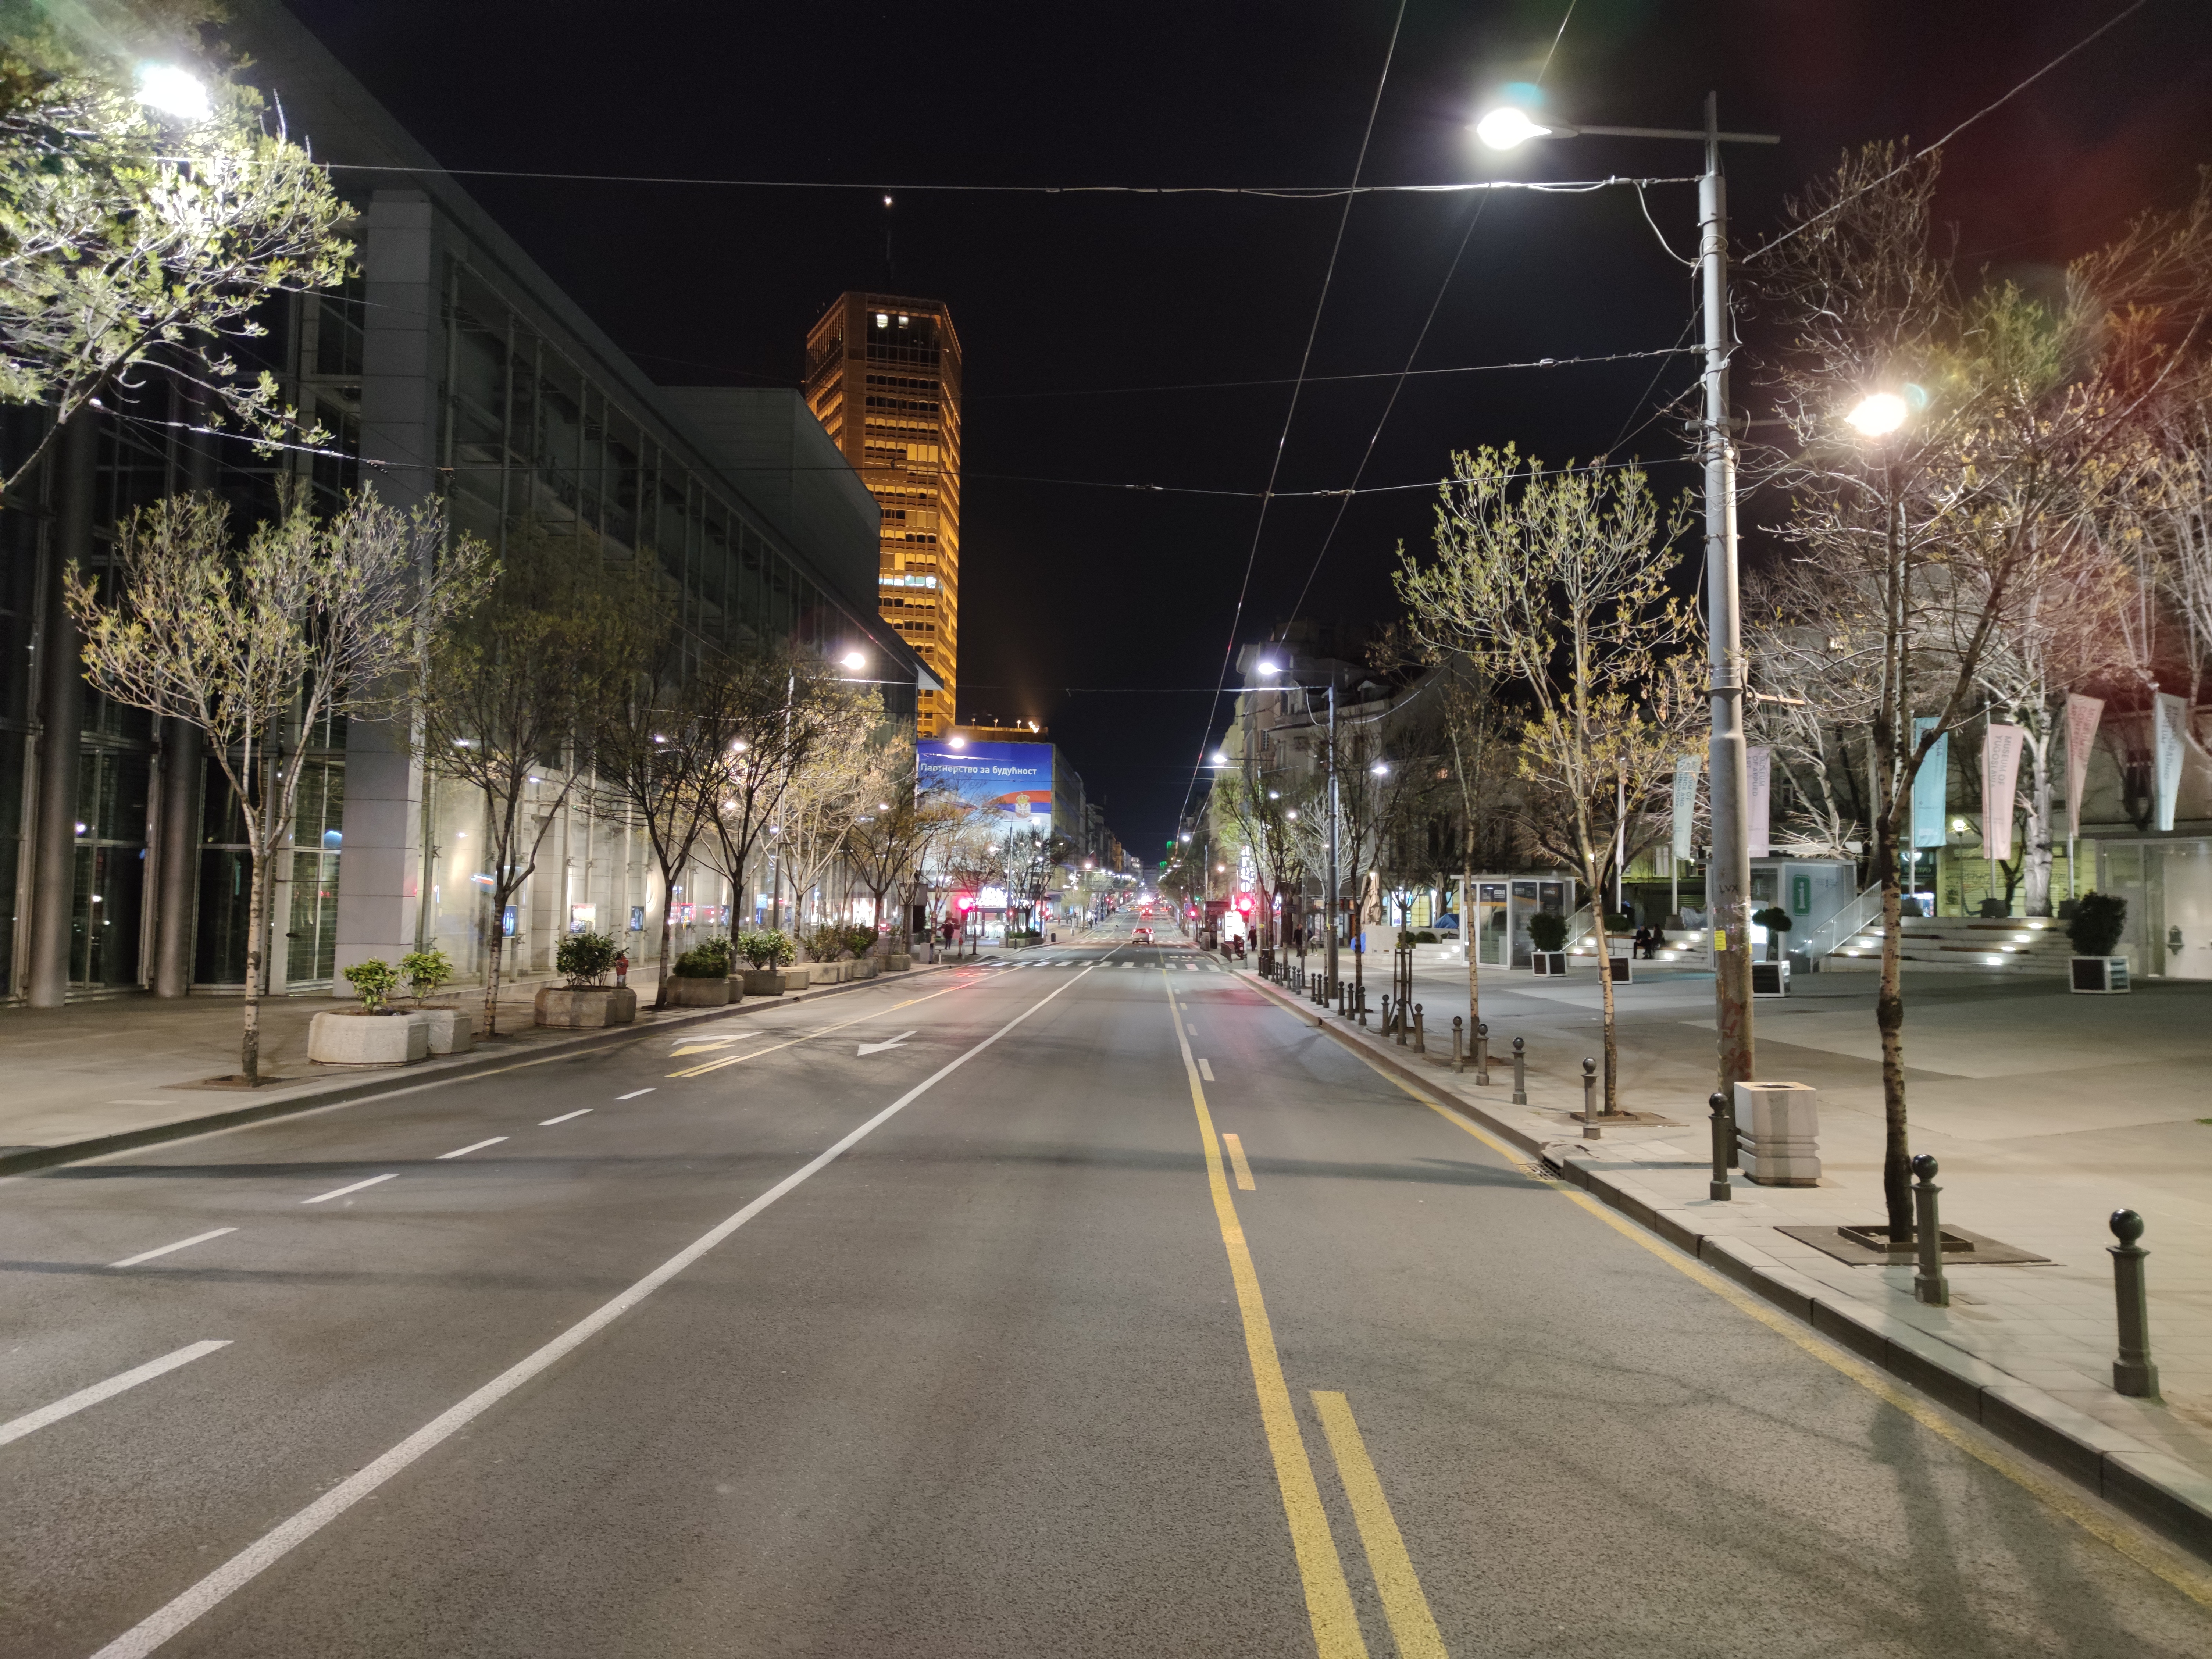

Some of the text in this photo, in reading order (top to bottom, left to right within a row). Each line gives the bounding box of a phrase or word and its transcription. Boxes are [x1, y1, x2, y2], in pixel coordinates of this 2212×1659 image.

[2080, 707, 2096, 746] MUSEUM
[920, 763, 978, 774] Партнерство
[992, 766, 1037, 777] будућност
[1752, 756, 1758, 766] OF
[1998, 736, 2012, 786] MUSEUM OF
[1685, 792, 1692, 801] OF
[1240, 845, 1251, 893] argo
